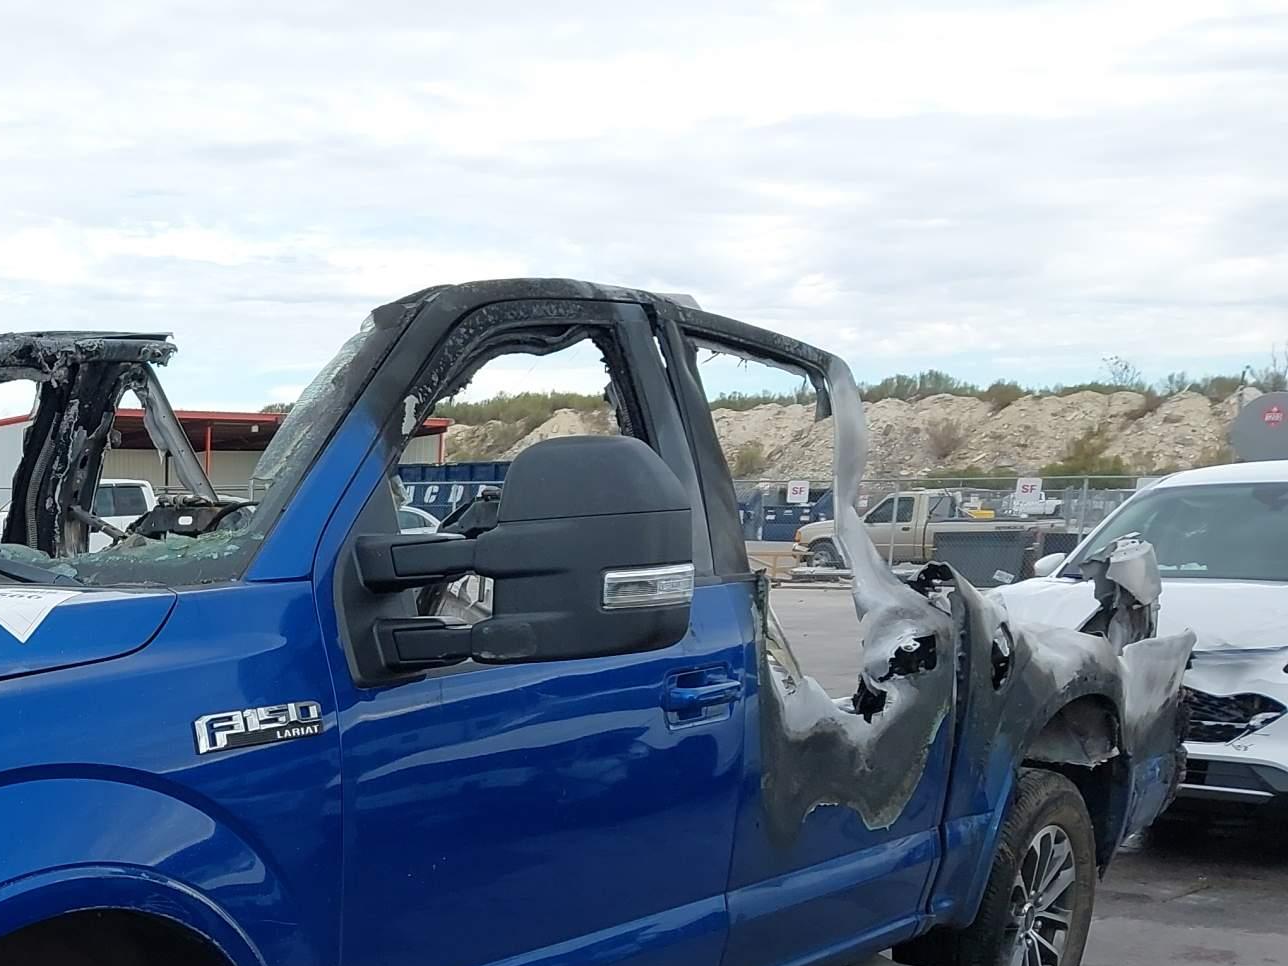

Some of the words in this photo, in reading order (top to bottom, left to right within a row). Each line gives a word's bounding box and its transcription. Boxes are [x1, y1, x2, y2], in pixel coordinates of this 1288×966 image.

[791, 486, 806, 496] SF
[1021, 484, 1037, 494] SF
[276, 724, 320, 740] LARIAT
